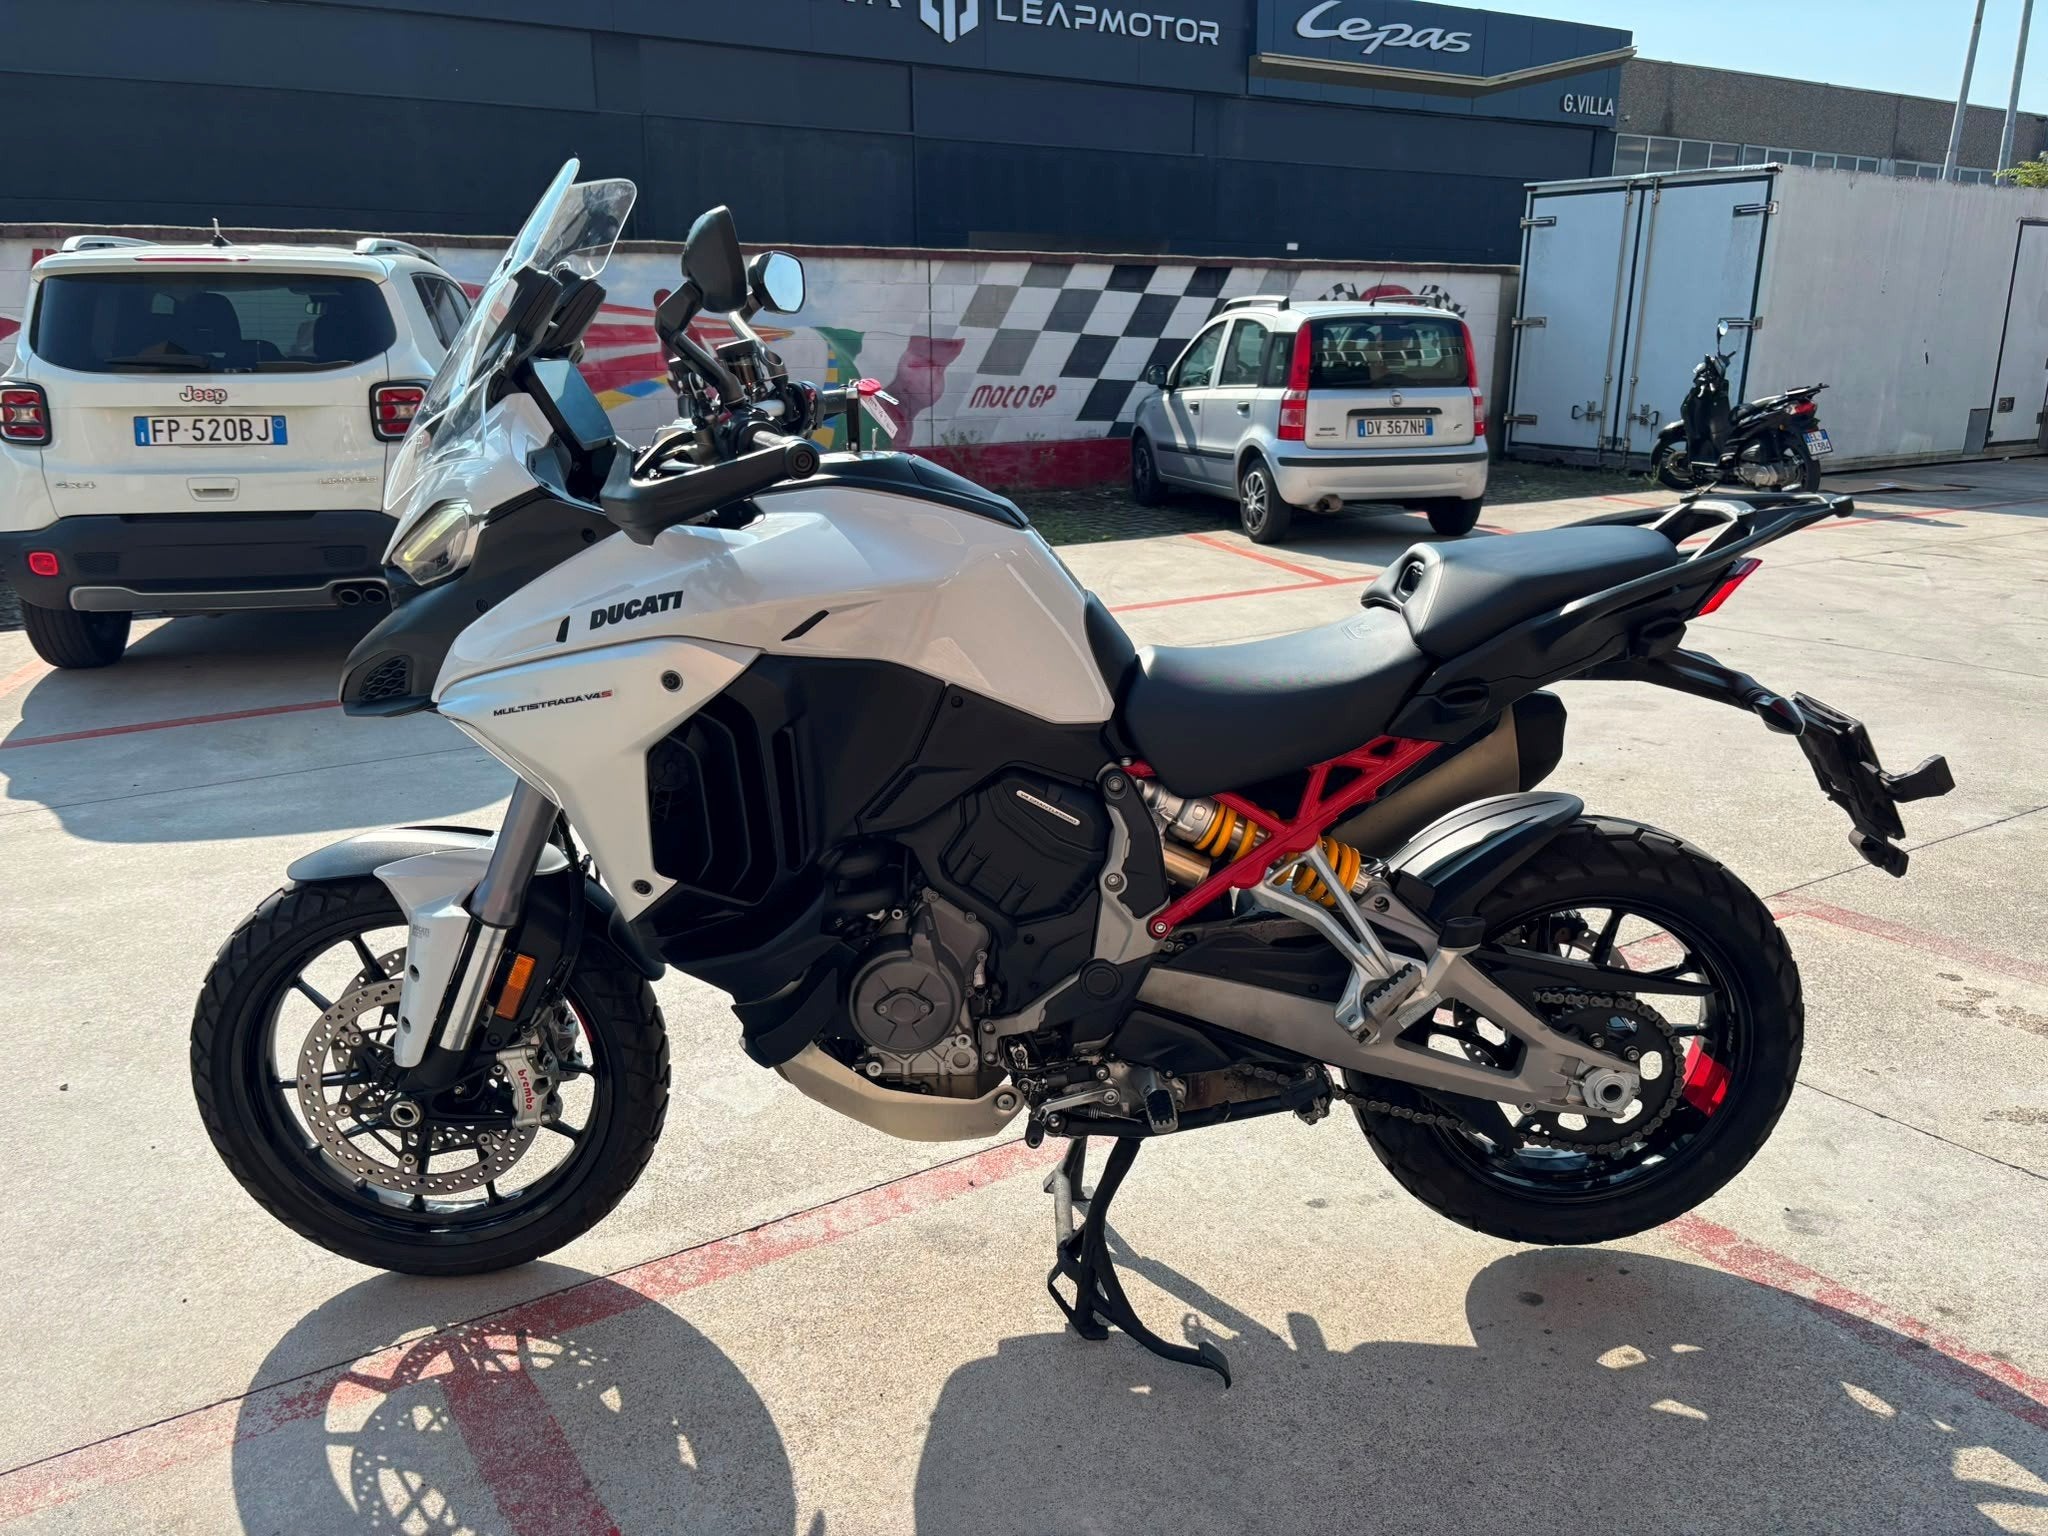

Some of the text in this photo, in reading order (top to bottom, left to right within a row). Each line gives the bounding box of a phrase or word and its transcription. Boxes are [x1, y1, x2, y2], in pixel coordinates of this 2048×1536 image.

[997, 0, 1219, 46] LEAPMOTOR
[1563, 93, 1615, 117] G.VILLA
[180, 386, 228, 404] Jeep
[1028, 384, 1057, 409] GP
[589, 590, 684, 630] DUCATI
[493, 695, 584, 716] MULTISTRADA
[517, 1068, 535, 1111] brembo
